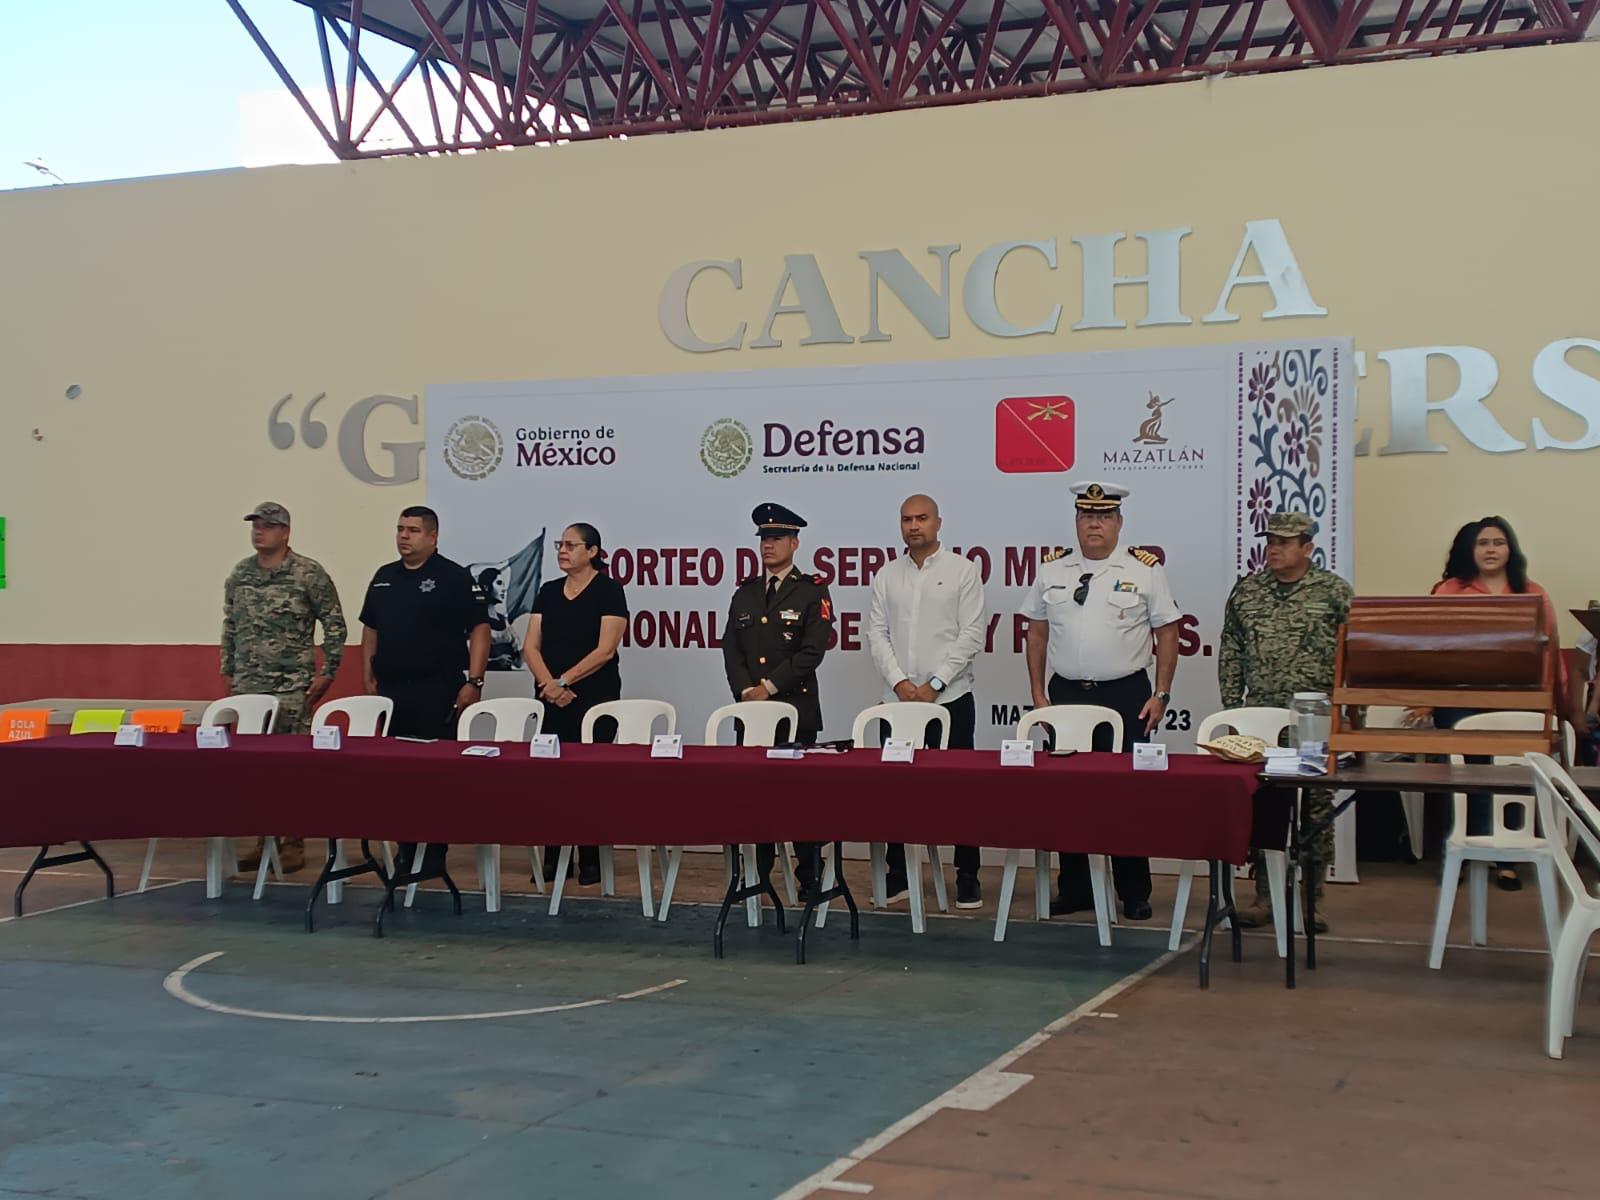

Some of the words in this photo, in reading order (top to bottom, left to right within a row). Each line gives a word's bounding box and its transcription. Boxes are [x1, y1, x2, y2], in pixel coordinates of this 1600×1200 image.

[658, 219, 1328, 353] CANCHA
[268, 391, 426, 487] “G
[516, 427, 590, 441] Gobierno
[595, 426, 615, 439] de
[763, 419, 925, 457] Defensa
[516, 440, 616, 467] México
[1103, 445, 1205, 464] MAZATLÁN
[762, 463, 810, 474] Secretaría
[812, 463, 824, 473] de
[826, 463, 835, 473] la
[837, 463, 875, 473] Defensa
[878, 461, 920, 472] Nacional
[10, 719, 35, 729] BOLA
